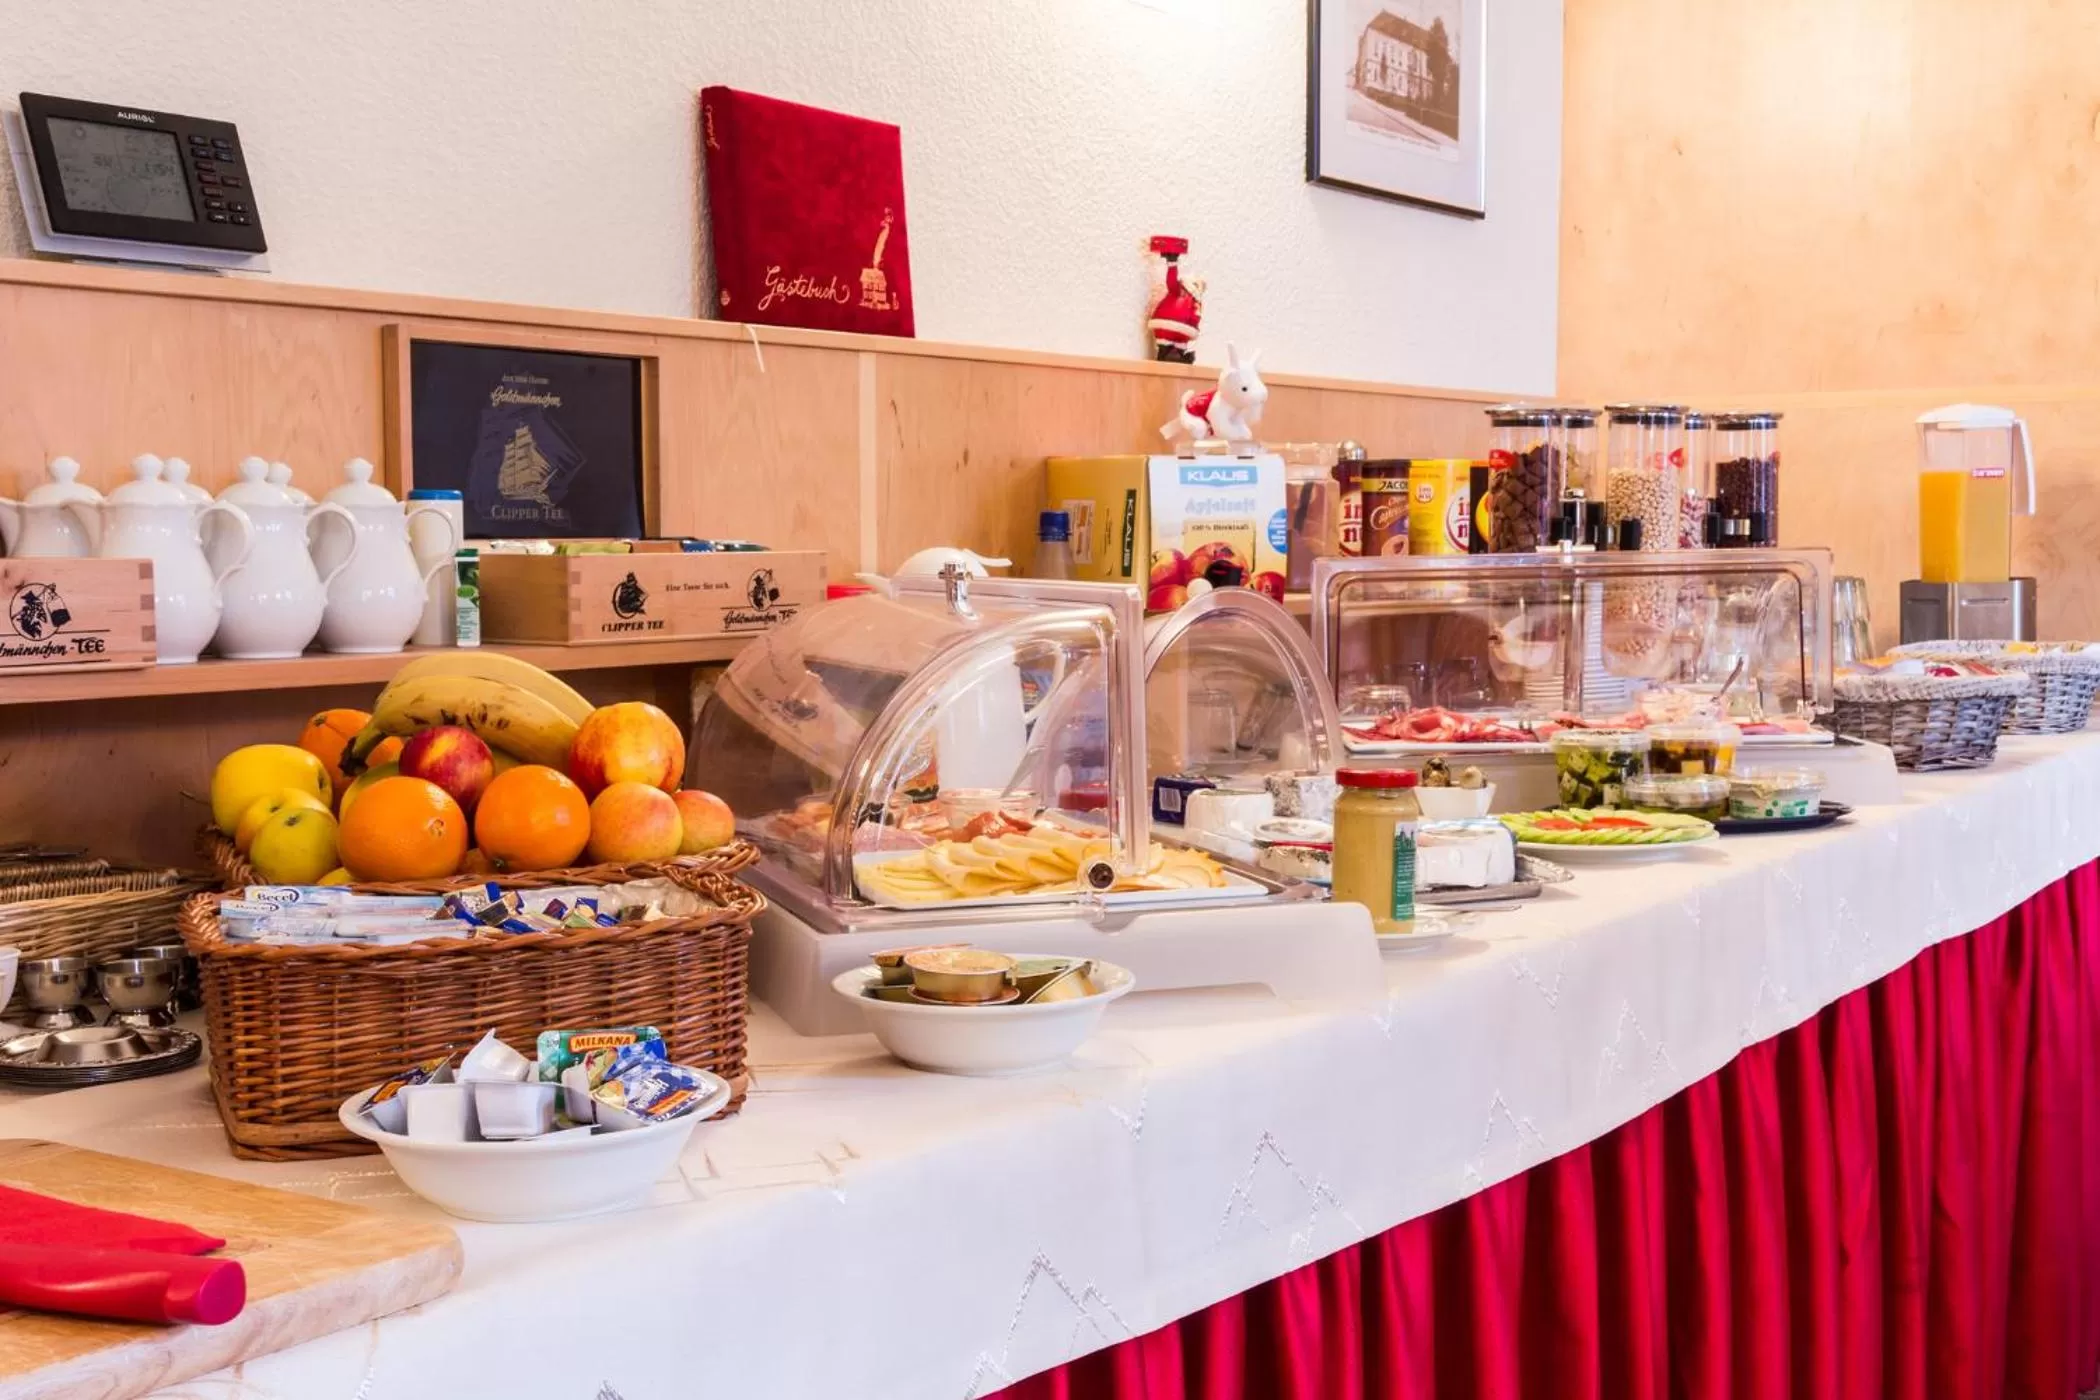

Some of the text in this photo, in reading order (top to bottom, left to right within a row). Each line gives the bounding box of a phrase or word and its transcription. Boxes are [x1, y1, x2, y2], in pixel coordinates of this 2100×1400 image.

[757, 264, 851, 311] Gästebuch
[1187, 470, 1249, 482] KLAUS
[490, 504, 539, 520] CLIPPER
[1184, 497, 1256, 516] Apfelsaft
[601, 620, 665, 633] CLIPPER TEE
[257, 892, 295, 903] Becel
[574, 1035, 632, 1050] MILKANA
